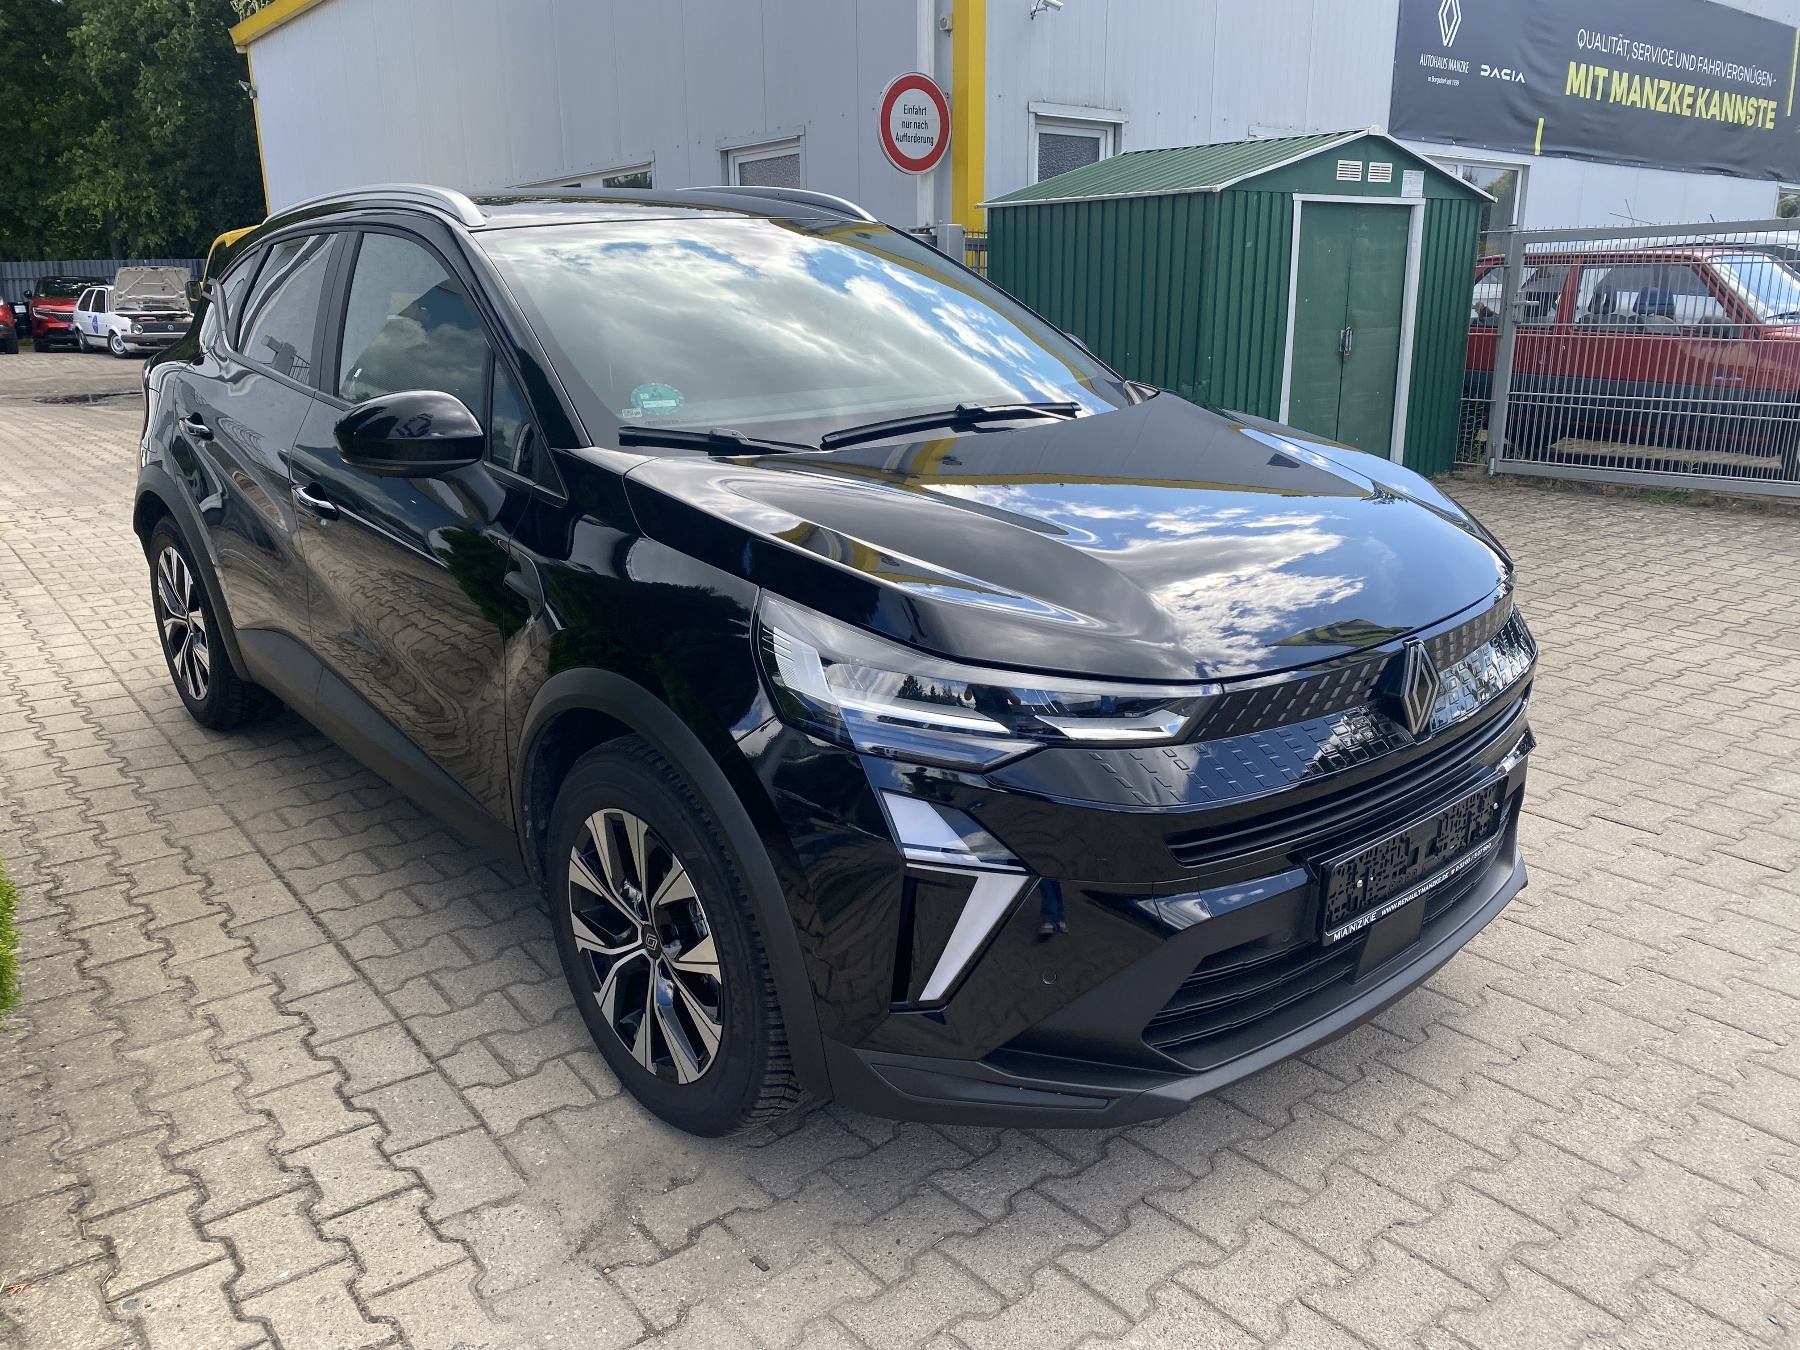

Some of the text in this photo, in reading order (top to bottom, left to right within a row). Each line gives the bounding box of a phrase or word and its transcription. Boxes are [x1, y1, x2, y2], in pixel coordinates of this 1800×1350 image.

[1577, 28, 1630, 61] QUALITÄT,
[1631, 41, 1675, 67] SERVICE
[1675, 52, 1697, 71] UND
[1420, 53, 1470, 74] AUTOHAUS MANZKE
[1480, 64, 1525, 83] DACIA
[1565, 61, 1777, 129] MIT MANZKE KANNSTE
[903, 104, 927, 116] Einfahrt
[901, 120, 928, 130] nur nach
[895, 132, 934, 147] Aufforderung
[1333, 911, 1376, 942] MANZKE
